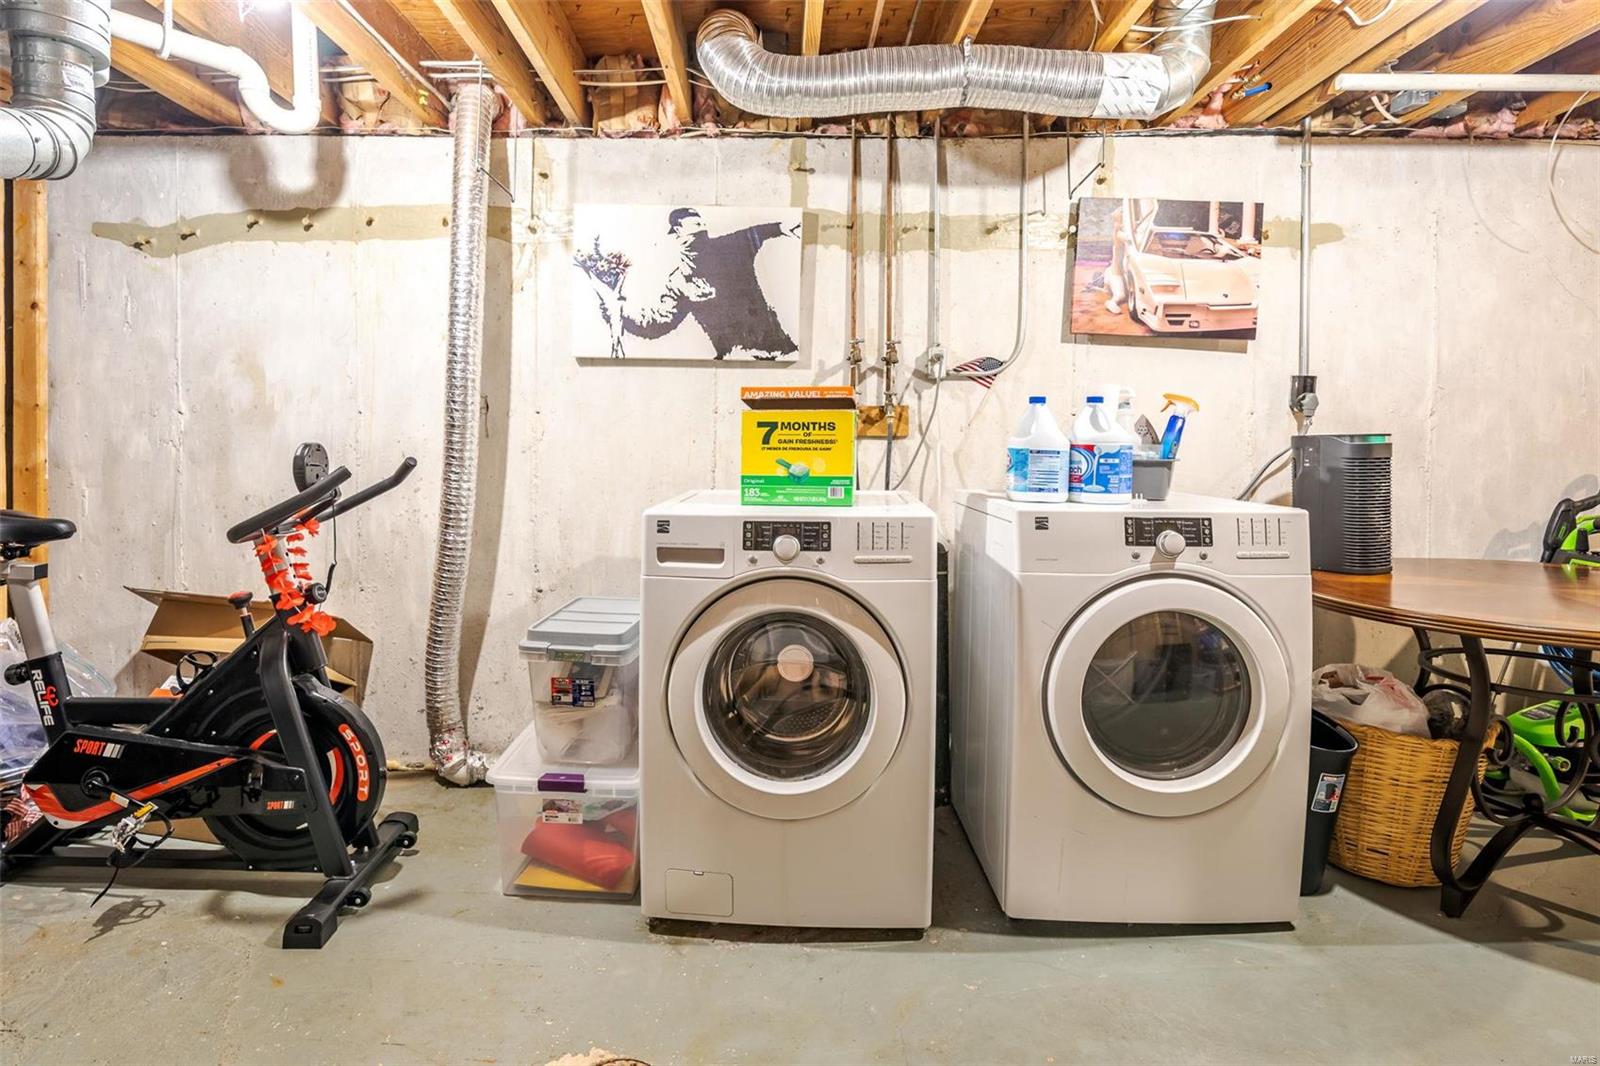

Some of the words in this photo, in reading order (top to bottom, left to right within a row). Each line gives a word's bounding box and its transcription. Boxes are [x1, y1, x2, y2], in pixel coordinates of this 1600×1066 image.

[743, 391, 786, 399] AMAZING
[787, 390, 820, 398] VALUE!
[757, 421, 779, 445] 7
[780, 421, 836, 431] MONTHS
[743, 488, 760, 497] 183
[31, 669, 55, 727] RELIFE
[73, 738, 106, 756] SPORT
[343, 729, 369, 793] SPORT
[266, 800, 284, 810] SPORT
